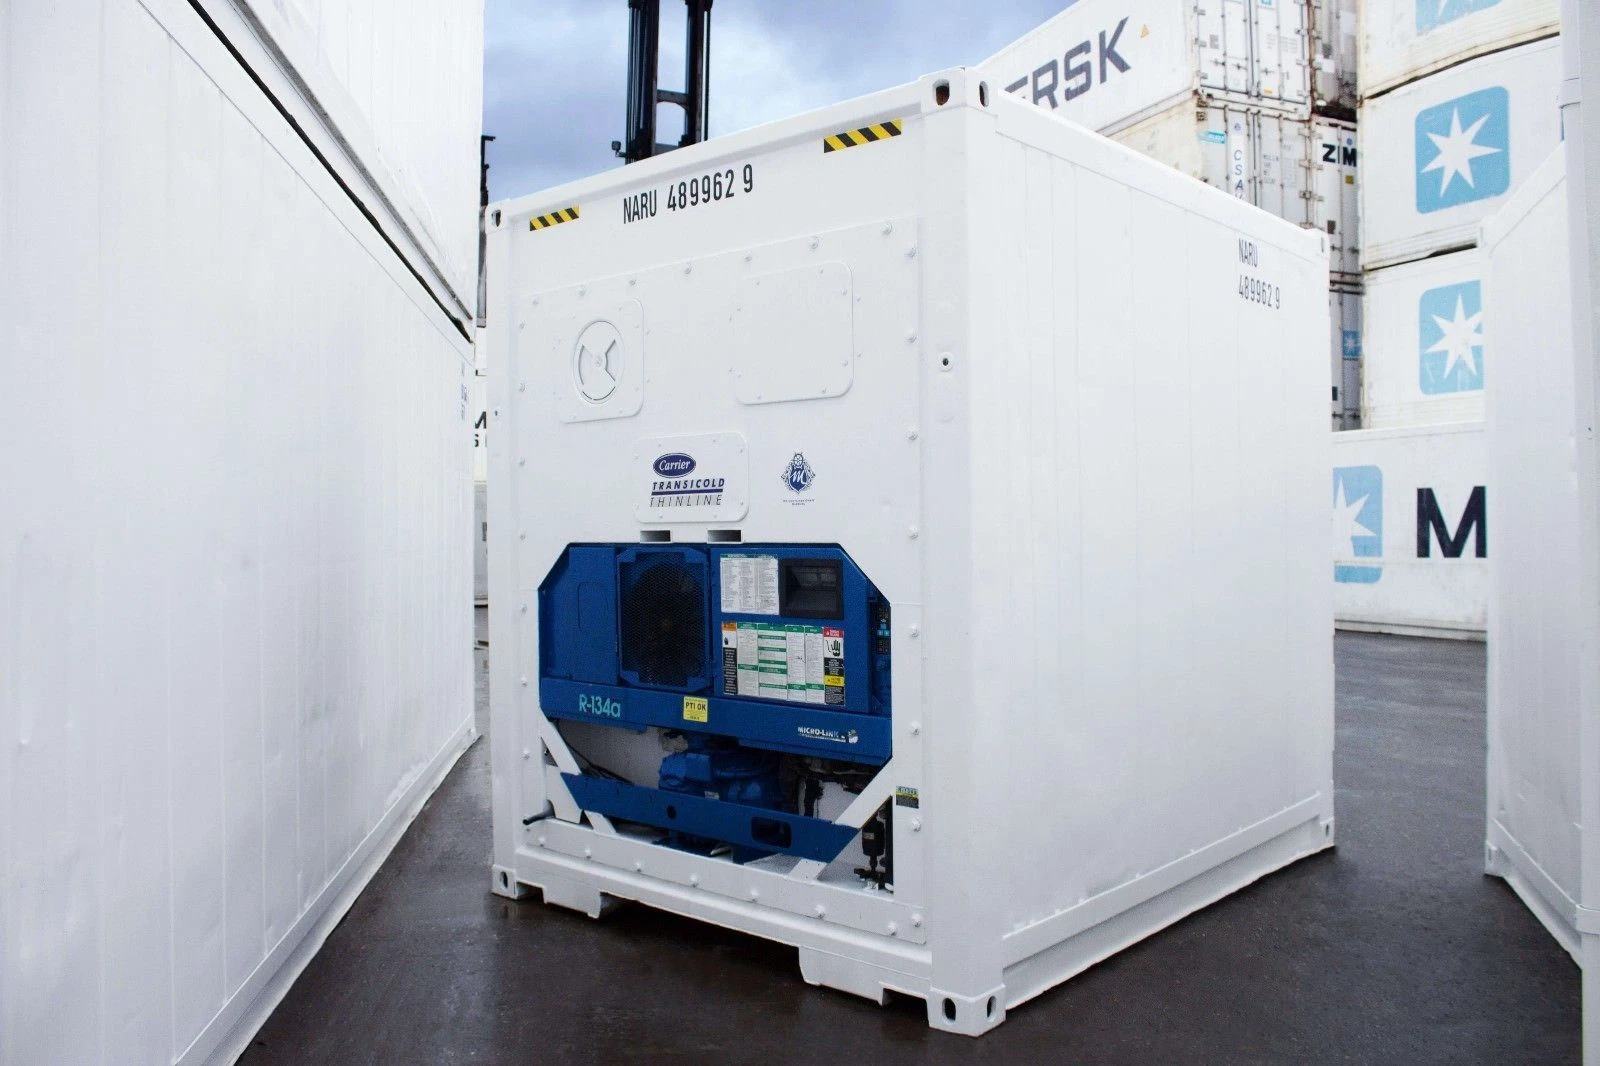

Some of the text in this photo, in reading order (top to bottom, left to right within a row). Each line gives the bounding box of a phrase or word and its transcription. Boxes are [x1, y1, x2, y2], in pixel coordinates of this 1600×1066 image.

[1322, 143, 1357, 167] ZIM
[623, 163, 753, 224] NARU 489962 9
[1239, 238, 1258, 267] NARU
[1239, 275, 1280, 310] 489962 9
[658, 459, 691, 471] Carrier
[653, 478, 725, 491] TRANSICOLD
[650, 494, 722, 508] THINLINE
[1416, 486, 1487, 558] M
[579, 694, 621, 718] R-134a
[685, 701, 706, 712] PTI OK
